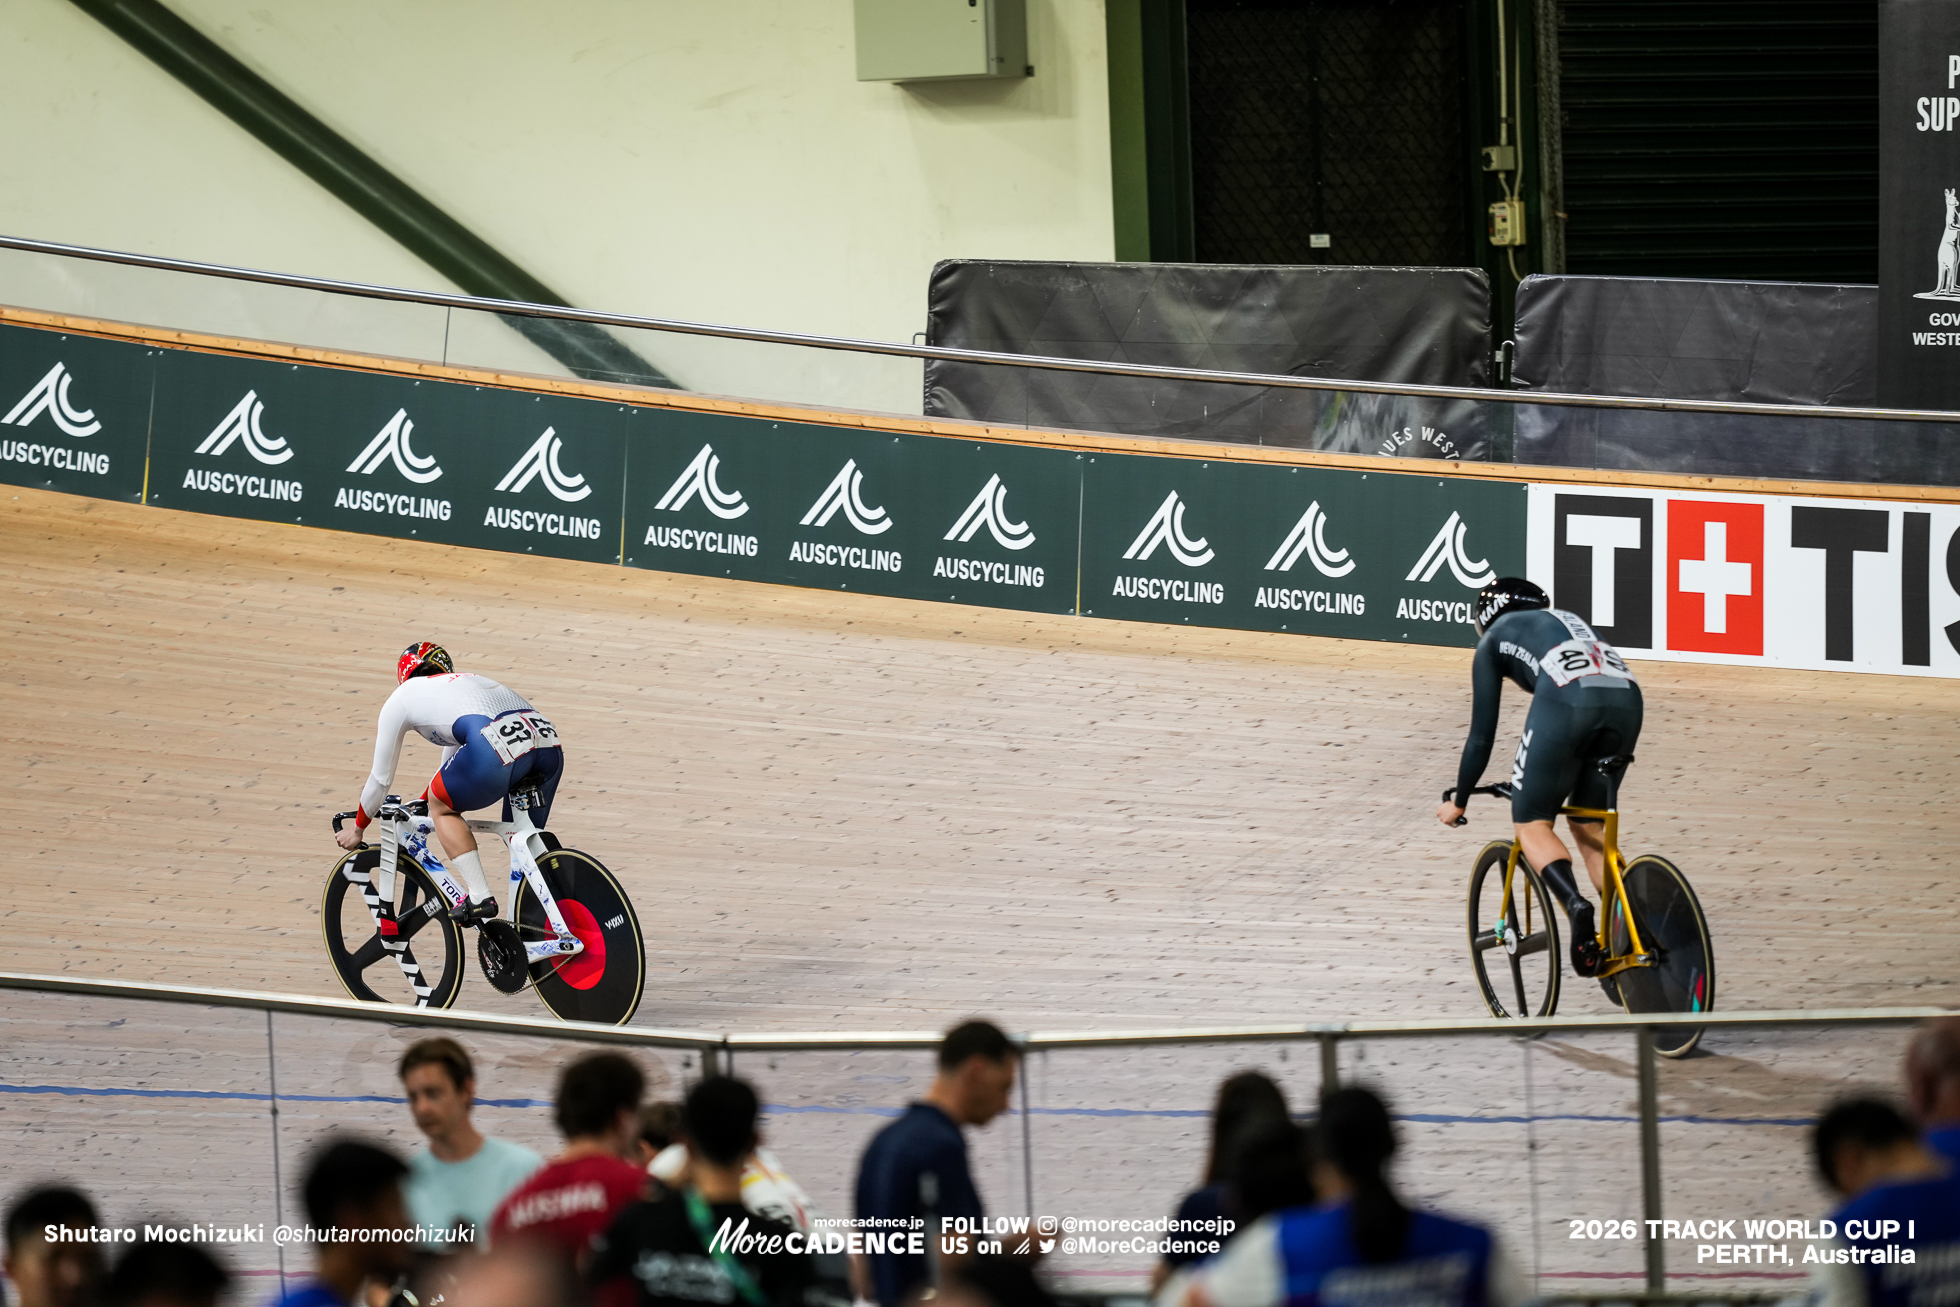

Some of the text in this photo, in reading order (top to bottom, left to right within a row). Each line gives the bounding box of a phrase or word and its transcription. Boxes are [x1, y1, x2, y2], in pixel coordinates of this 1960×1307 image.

[1916, 96, 1960, 132] SUP
[1929, 312, 1960, 327] GOV
[1912, 332, 1960, 346] WESTE
[0, 439, 110, 475] USCYCLING
[1422, 426, 1460, 460] WEST
[183, 467, 302, 503] AUSCYCLING
[335, 486, 451, 521] AUSCYCLING
[484, 505, 601, 540] AUSCYCLING
[644, 525, 758, 557] AUSCYCLING
[789, 541, 902, 573] AUSCYCLING
[933, 556, 1045, 588] AUSCYCLING
[1791, 505, 1960, 668] TI
[1113, 575, 1224, 605] AUSCYCLING
[1255, 586, 1365, 616] AUSCYCLING
[1396, 597, 1474, 624] AUSCYCL
[1558, 649, 1590, 671] 40
[499, 721, 532, 746] 37
[1511, 728, 1533, 791] NZL
[441, 878, 461, 902] TOR
